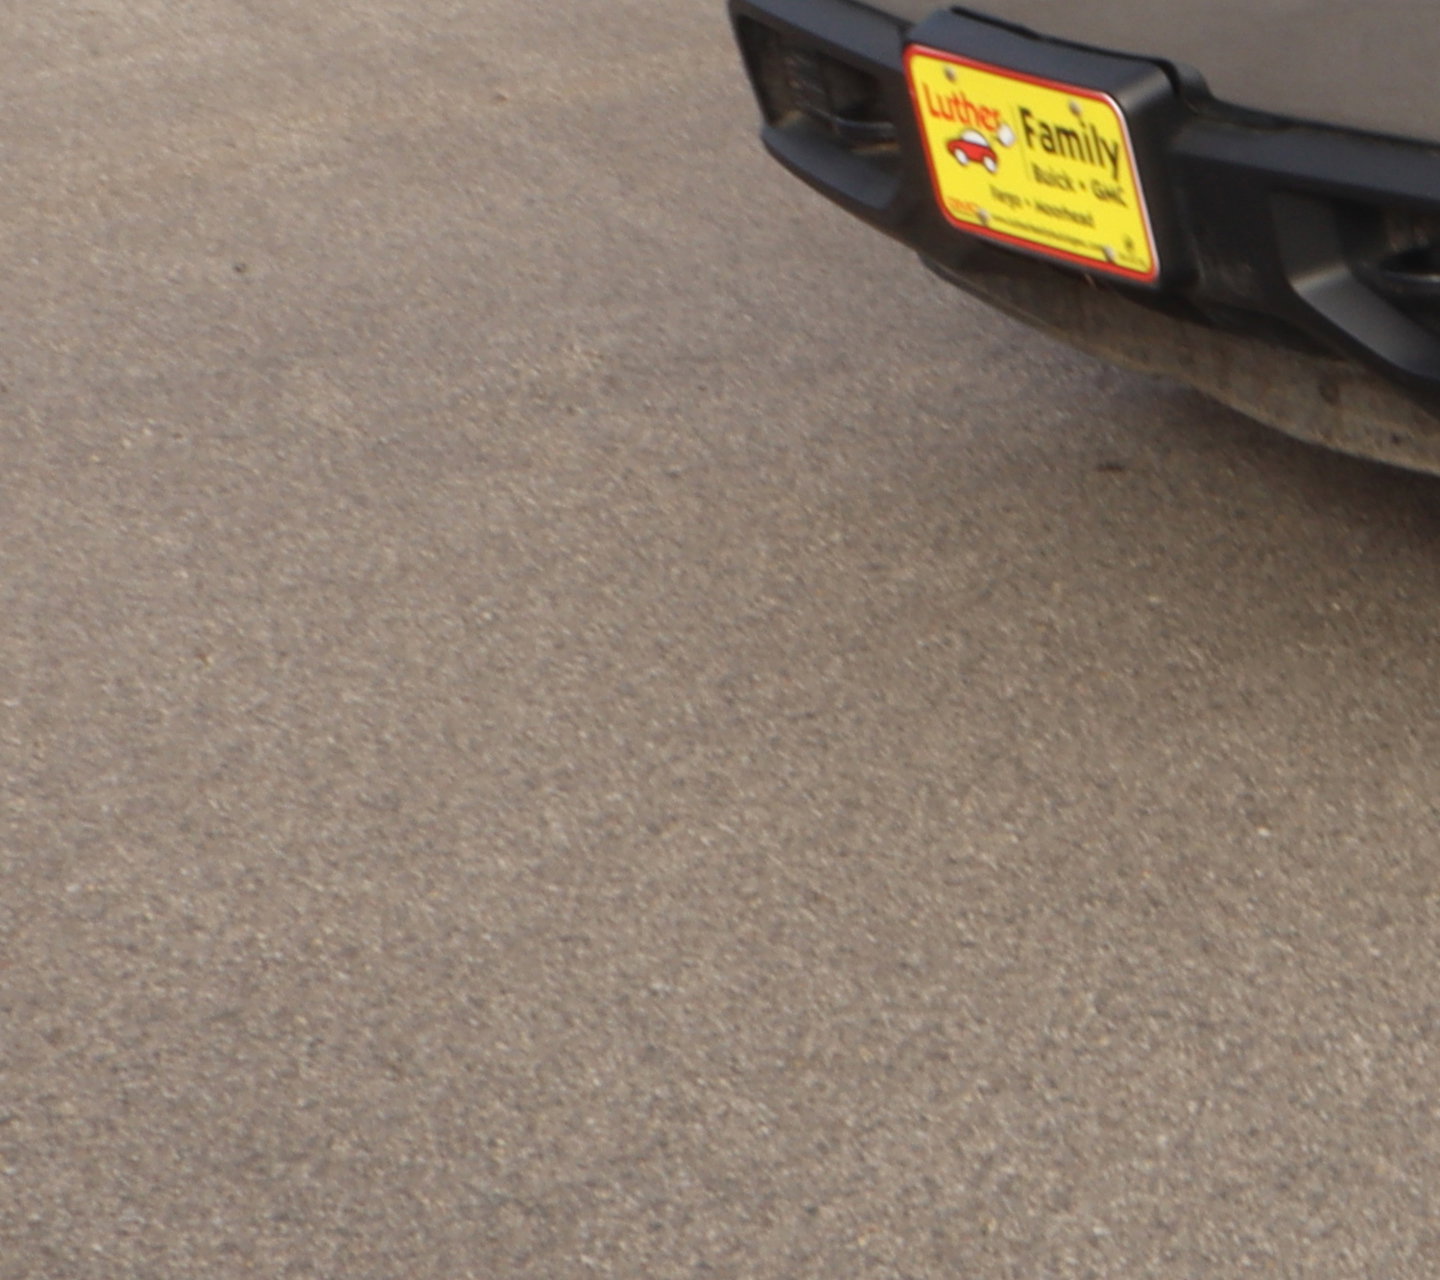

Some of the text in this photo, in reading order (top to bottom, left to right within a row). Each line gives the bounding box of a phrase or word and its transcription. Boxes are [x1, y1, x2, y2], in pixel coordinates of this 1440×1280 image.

[922, 82, 1120, 181] Luther Family
[1033, 162, 1129, 209] Buick GMC
